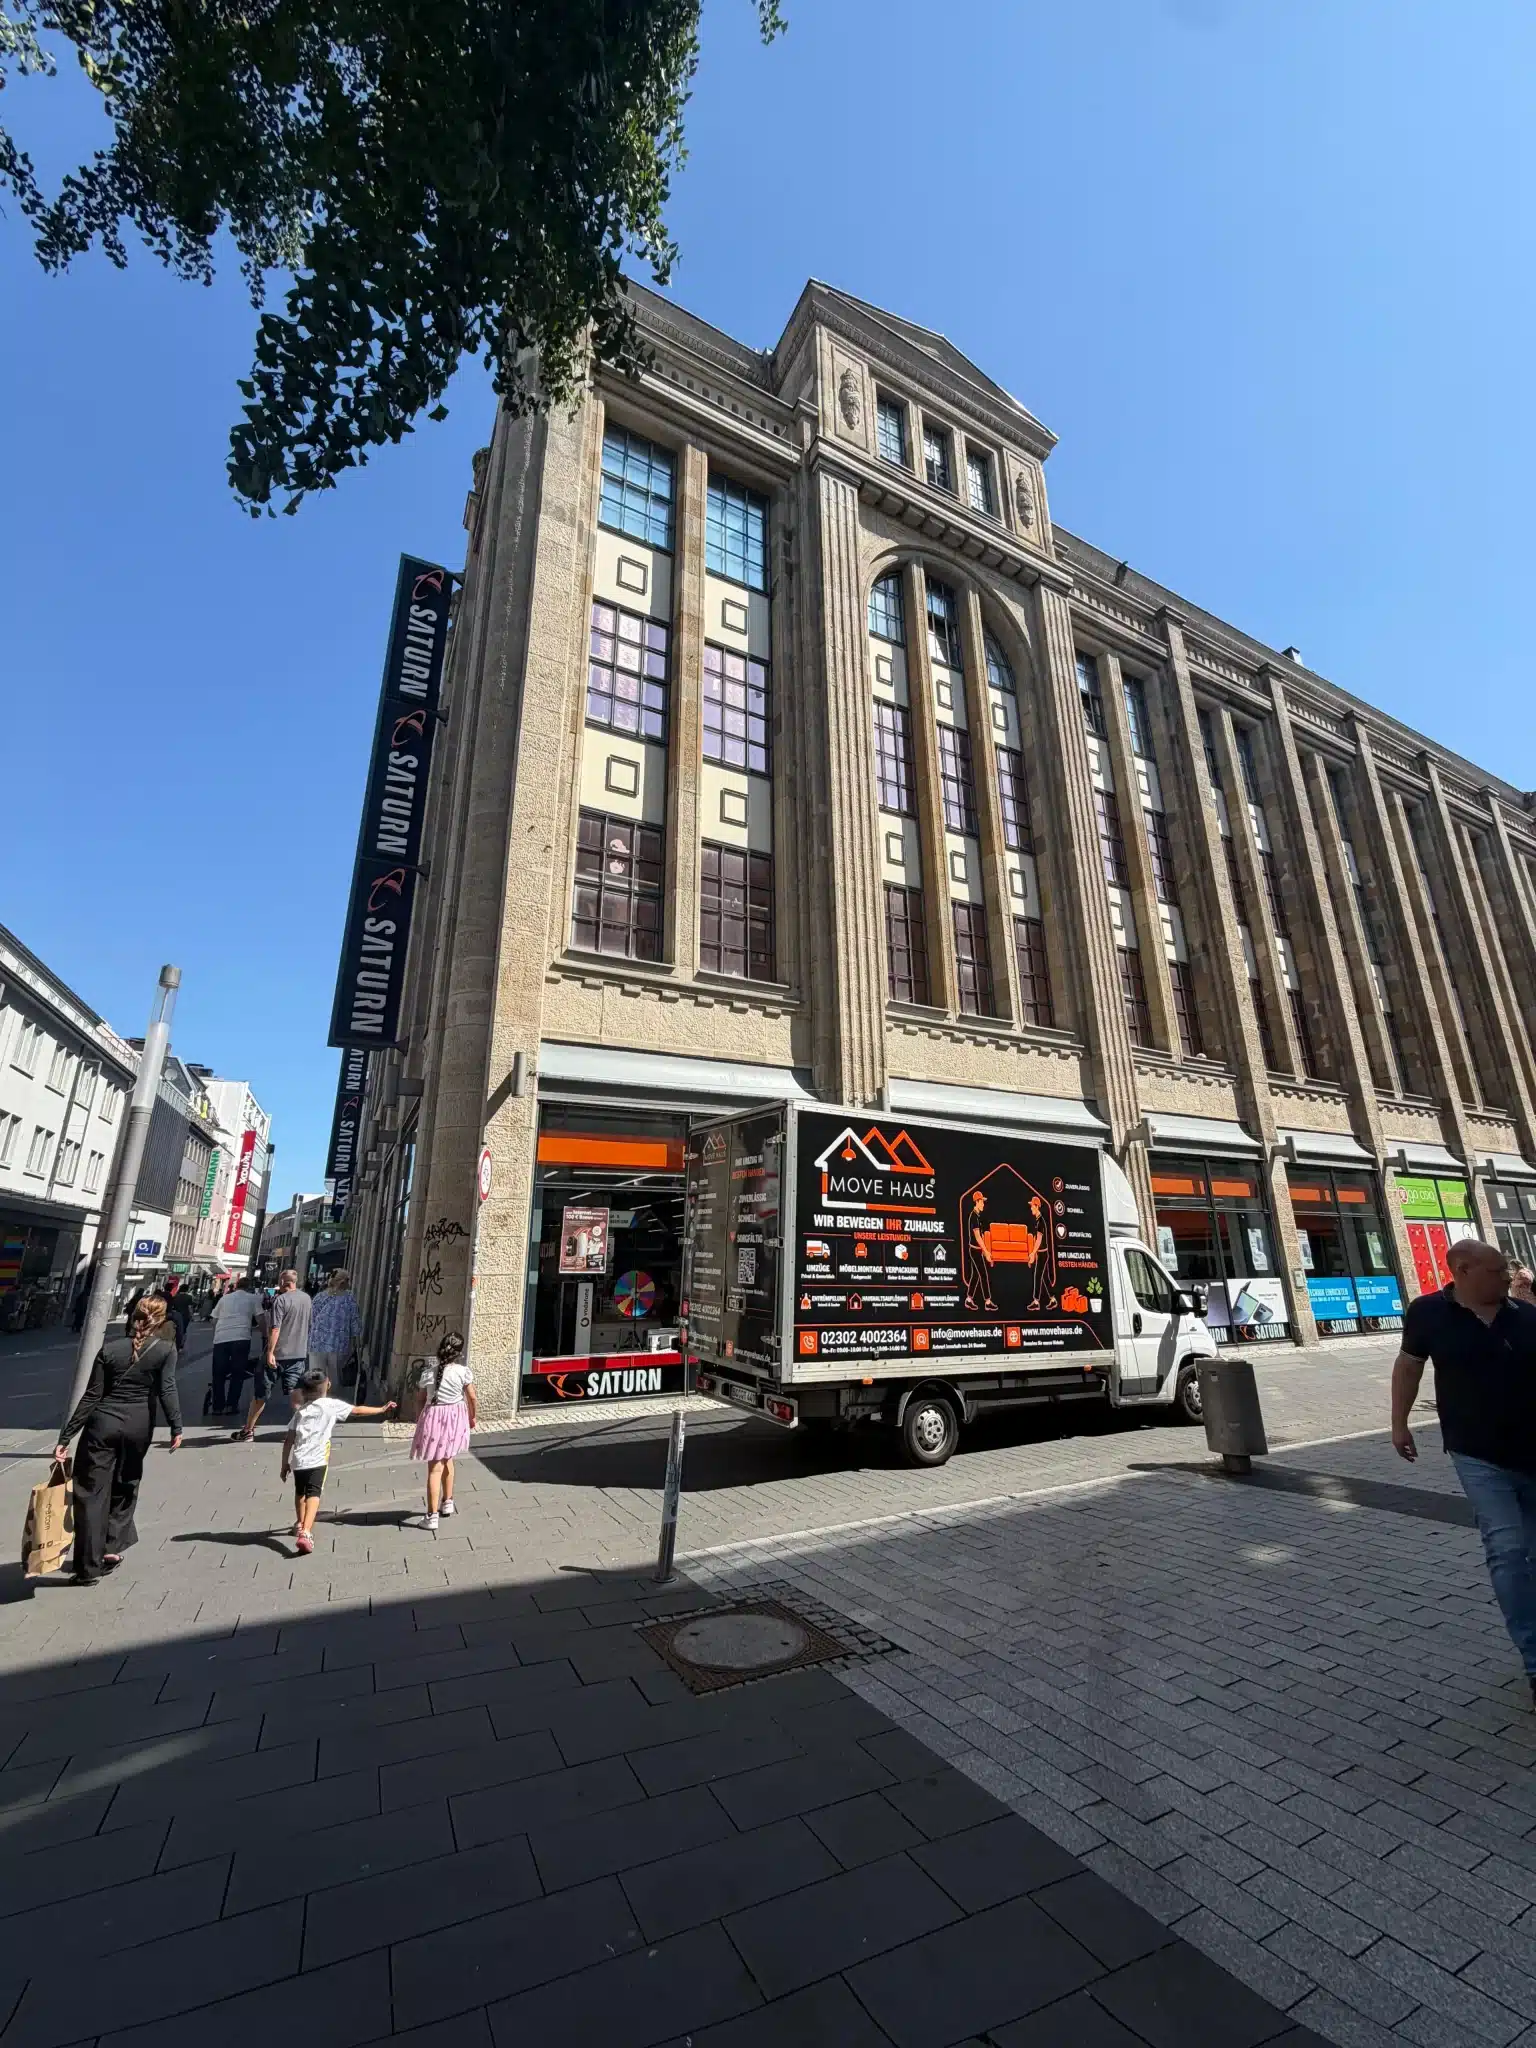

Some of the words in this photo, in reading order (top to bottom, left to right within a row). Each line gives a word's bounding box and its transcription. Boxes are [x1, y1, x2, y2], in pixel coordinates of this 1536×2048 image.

[399, 604, 438, 698] SATURN
[376, 751, 418, 855] SATURN
[350, 917, 397, 1034] SATURN
[346, 1048, 365, 1091] ATURN
[334, 1120, 355, 1173] SATURN
[200, 1150, 220, 1217] DEICHMANN
[830, 1176, 883, 1195] MOVE
[890, 1181, 934, 1199] HAUS
[814, 1214, 834, 1228] WIR
[836, 1216, 884, 1230] BEWEGEN
[886, 1218, 902, 1231] IHR
[904, 1220, 944, 1233] ZUHAUSE
[854, 1232, 876, 1240] UNSERE
[878, 1233, 911, 1242] LEISTUNGEN
[806, 1263, 830, 1272] UMZÜGE
[839, 1264, 884, 1273] MÖBELMONTAGE
[885, 1266, 918, 1274] VERPACKUNG
[1022, 1325, 1083, 1336] www.movehaus.de
[1330, 1319, 1358, 1334] SATURN
[1378, 1316, 1403, 1330] SATURN
[820, 1331, 857, 1345] 02302
[860, 1330, 907, 1344] 4002364
[930, 1326, 1003, 1340] info@movehaus.de
[1254, 1324, 1286, 1340] SATURN
[586, 1368, 662, 1396] SATURN
